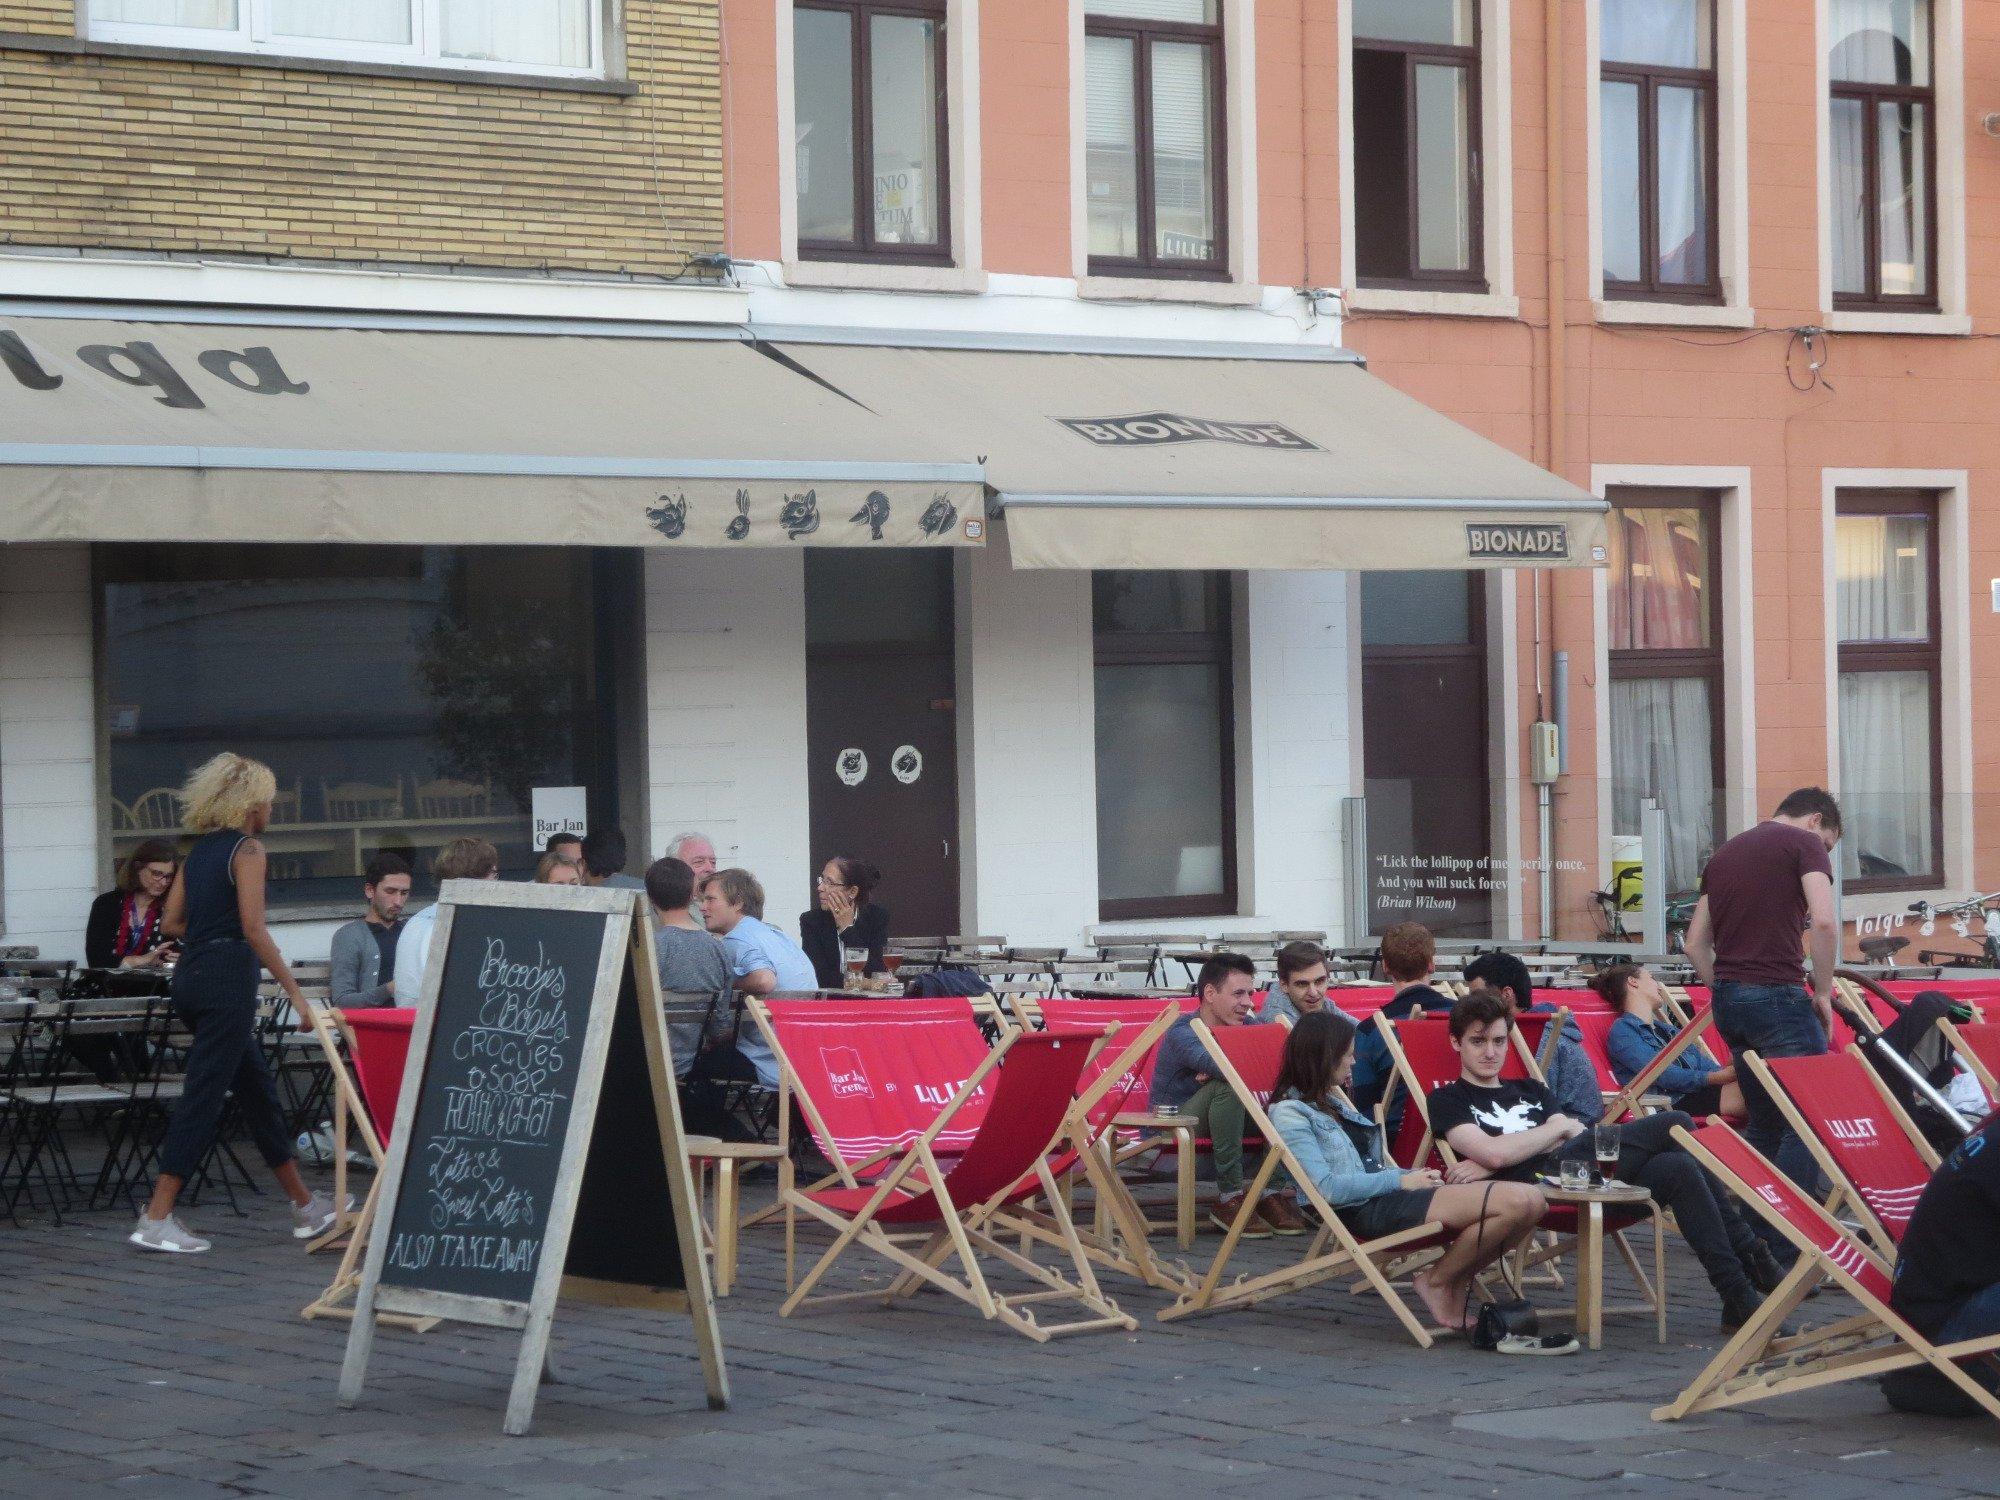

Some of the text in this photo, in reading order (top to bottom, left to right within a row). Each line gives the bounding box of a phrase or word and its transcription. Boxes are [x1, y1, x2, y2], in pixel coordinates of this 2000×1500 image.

[1071, 417, 1302, 445] BIONADE
[1470, 529, 1564, 552] BIONADE
[536, 818, 584, 832] Bar Jan
[1411, 856, 1428, 868] the
[1431, 855, 1472, 871] lollipop
[1476, 856, 1490, 869] of
[1377, 876, 1400, 888] And
[1403, 879, 1423, 891] you
[1426, 877, 1447, 889] will
[1450, 876, 1475, 889] suck
[1377, 895, 1456, 911] (Brian Wilson)
[1855, 912, 1904, 937] Volga
[479, 937, 566, 1008] Broodjes
[1824, 1118, 1878, 1139] LILLET
[388, 1233, 435, 1269] ALSO
